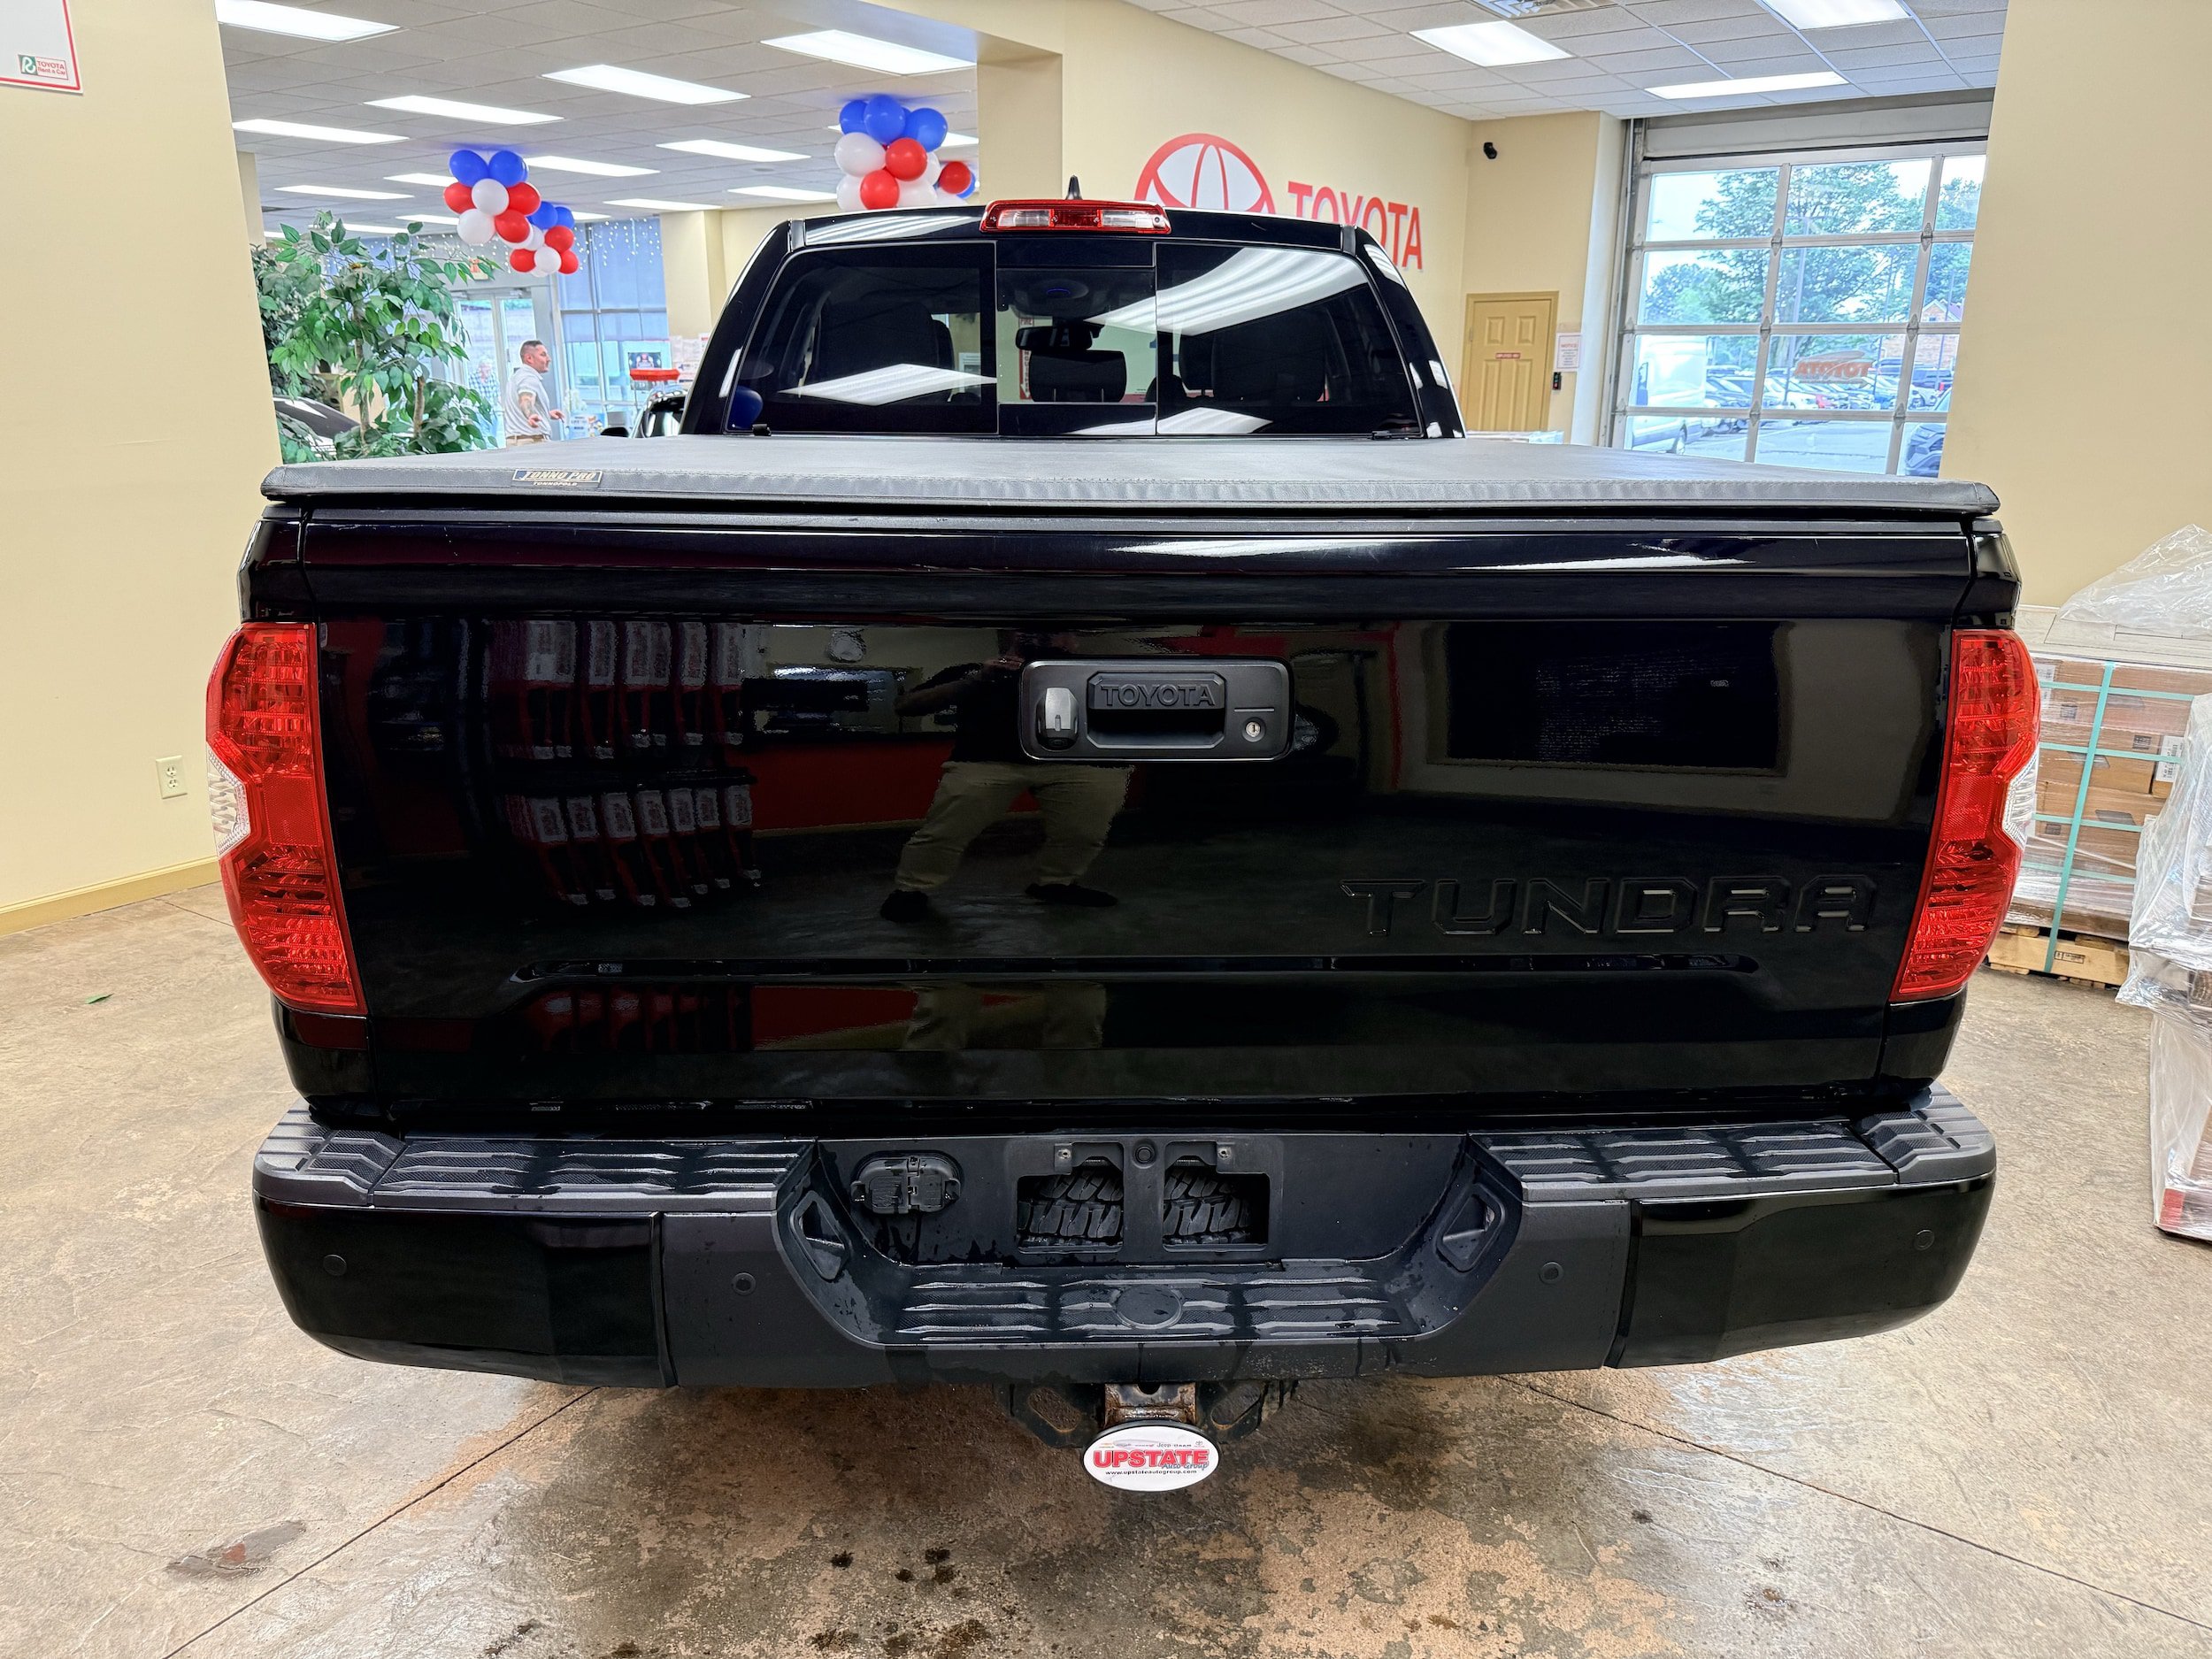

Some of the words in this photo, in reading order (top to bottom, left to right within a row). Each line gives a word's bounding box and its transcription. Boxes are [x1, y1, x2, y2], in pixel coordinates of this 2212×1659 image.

[518, 470, 569, 480] TONNO
[568, 472, 597, 480] PRO
[1101, 684, 1216, 707] TOYOTA
[1339, 877, 1878, 936] TUNDRA
[1093, 1449, 1210, 1469] UPSTATE
[1183, 1463, 1209, 1471] Group
